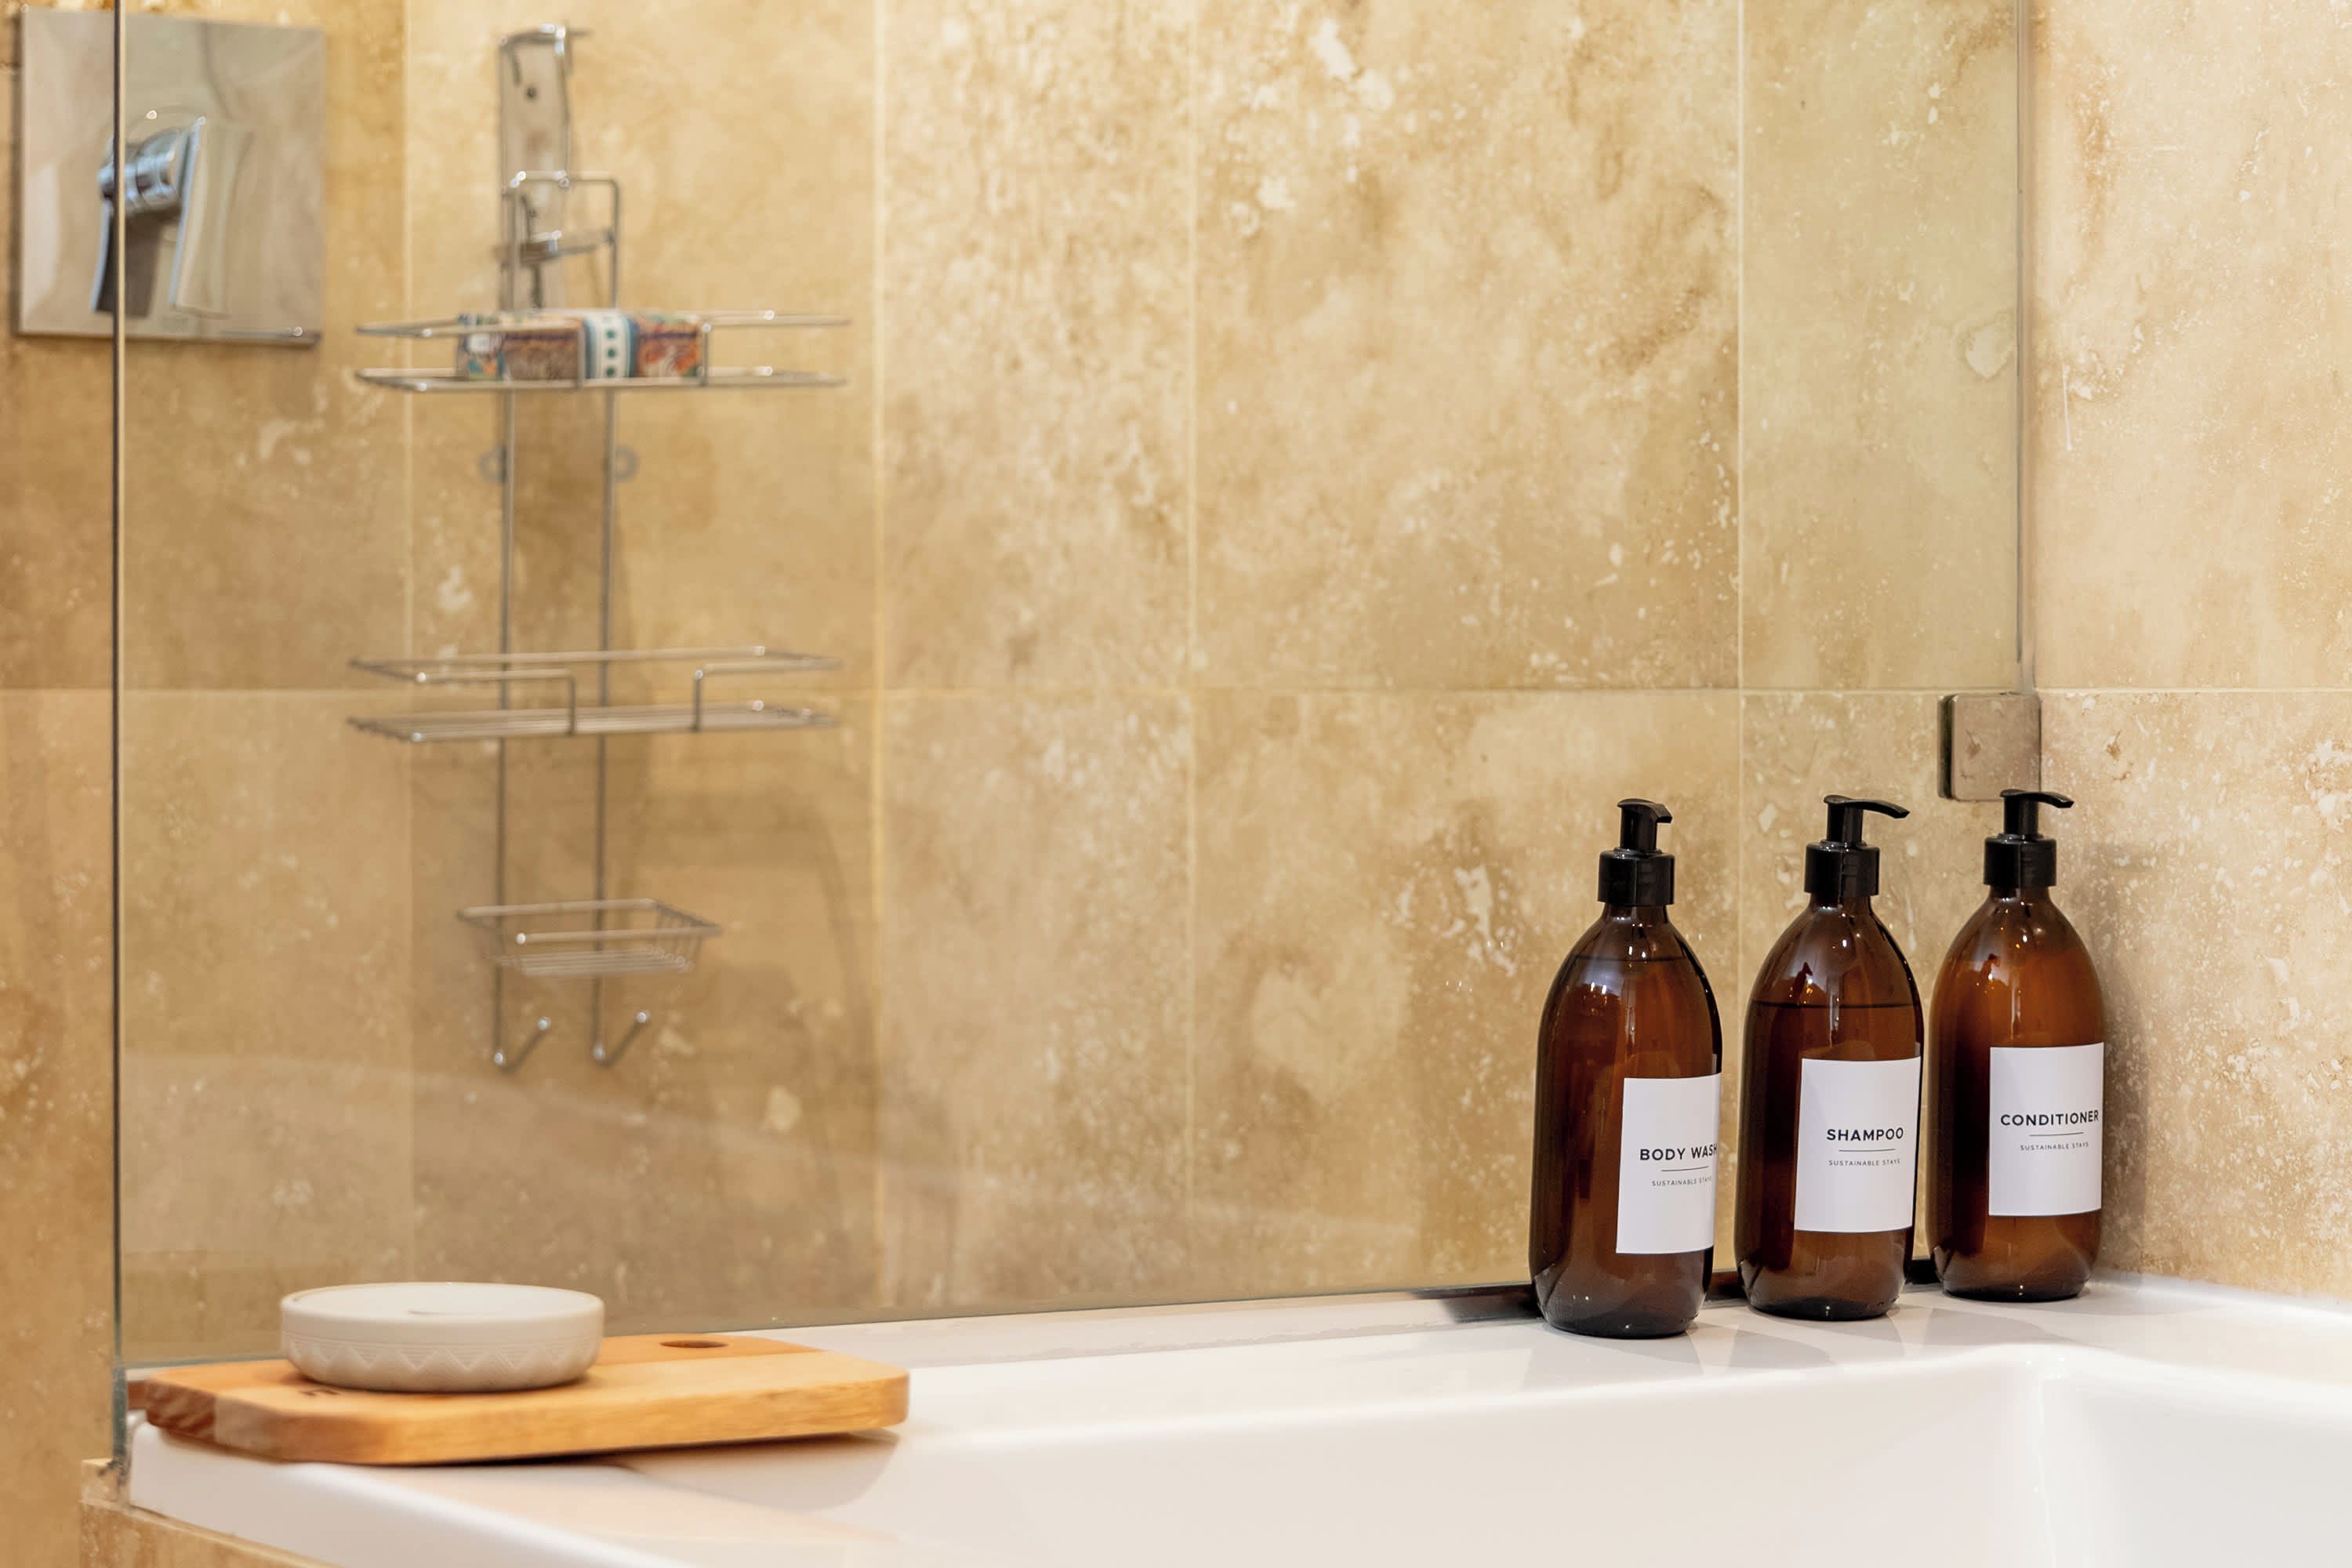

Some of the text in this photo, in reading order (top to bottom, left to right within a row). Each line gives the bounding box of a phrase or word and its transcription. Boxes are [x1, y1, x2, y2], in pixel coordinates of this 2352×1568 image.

[2000, 1110, 2099, 1126] CONDITIONER
[1826, 1127, 1904, 1142] SHAMPOO
[1639, 1143, 1718, 1161] BODY WASH
